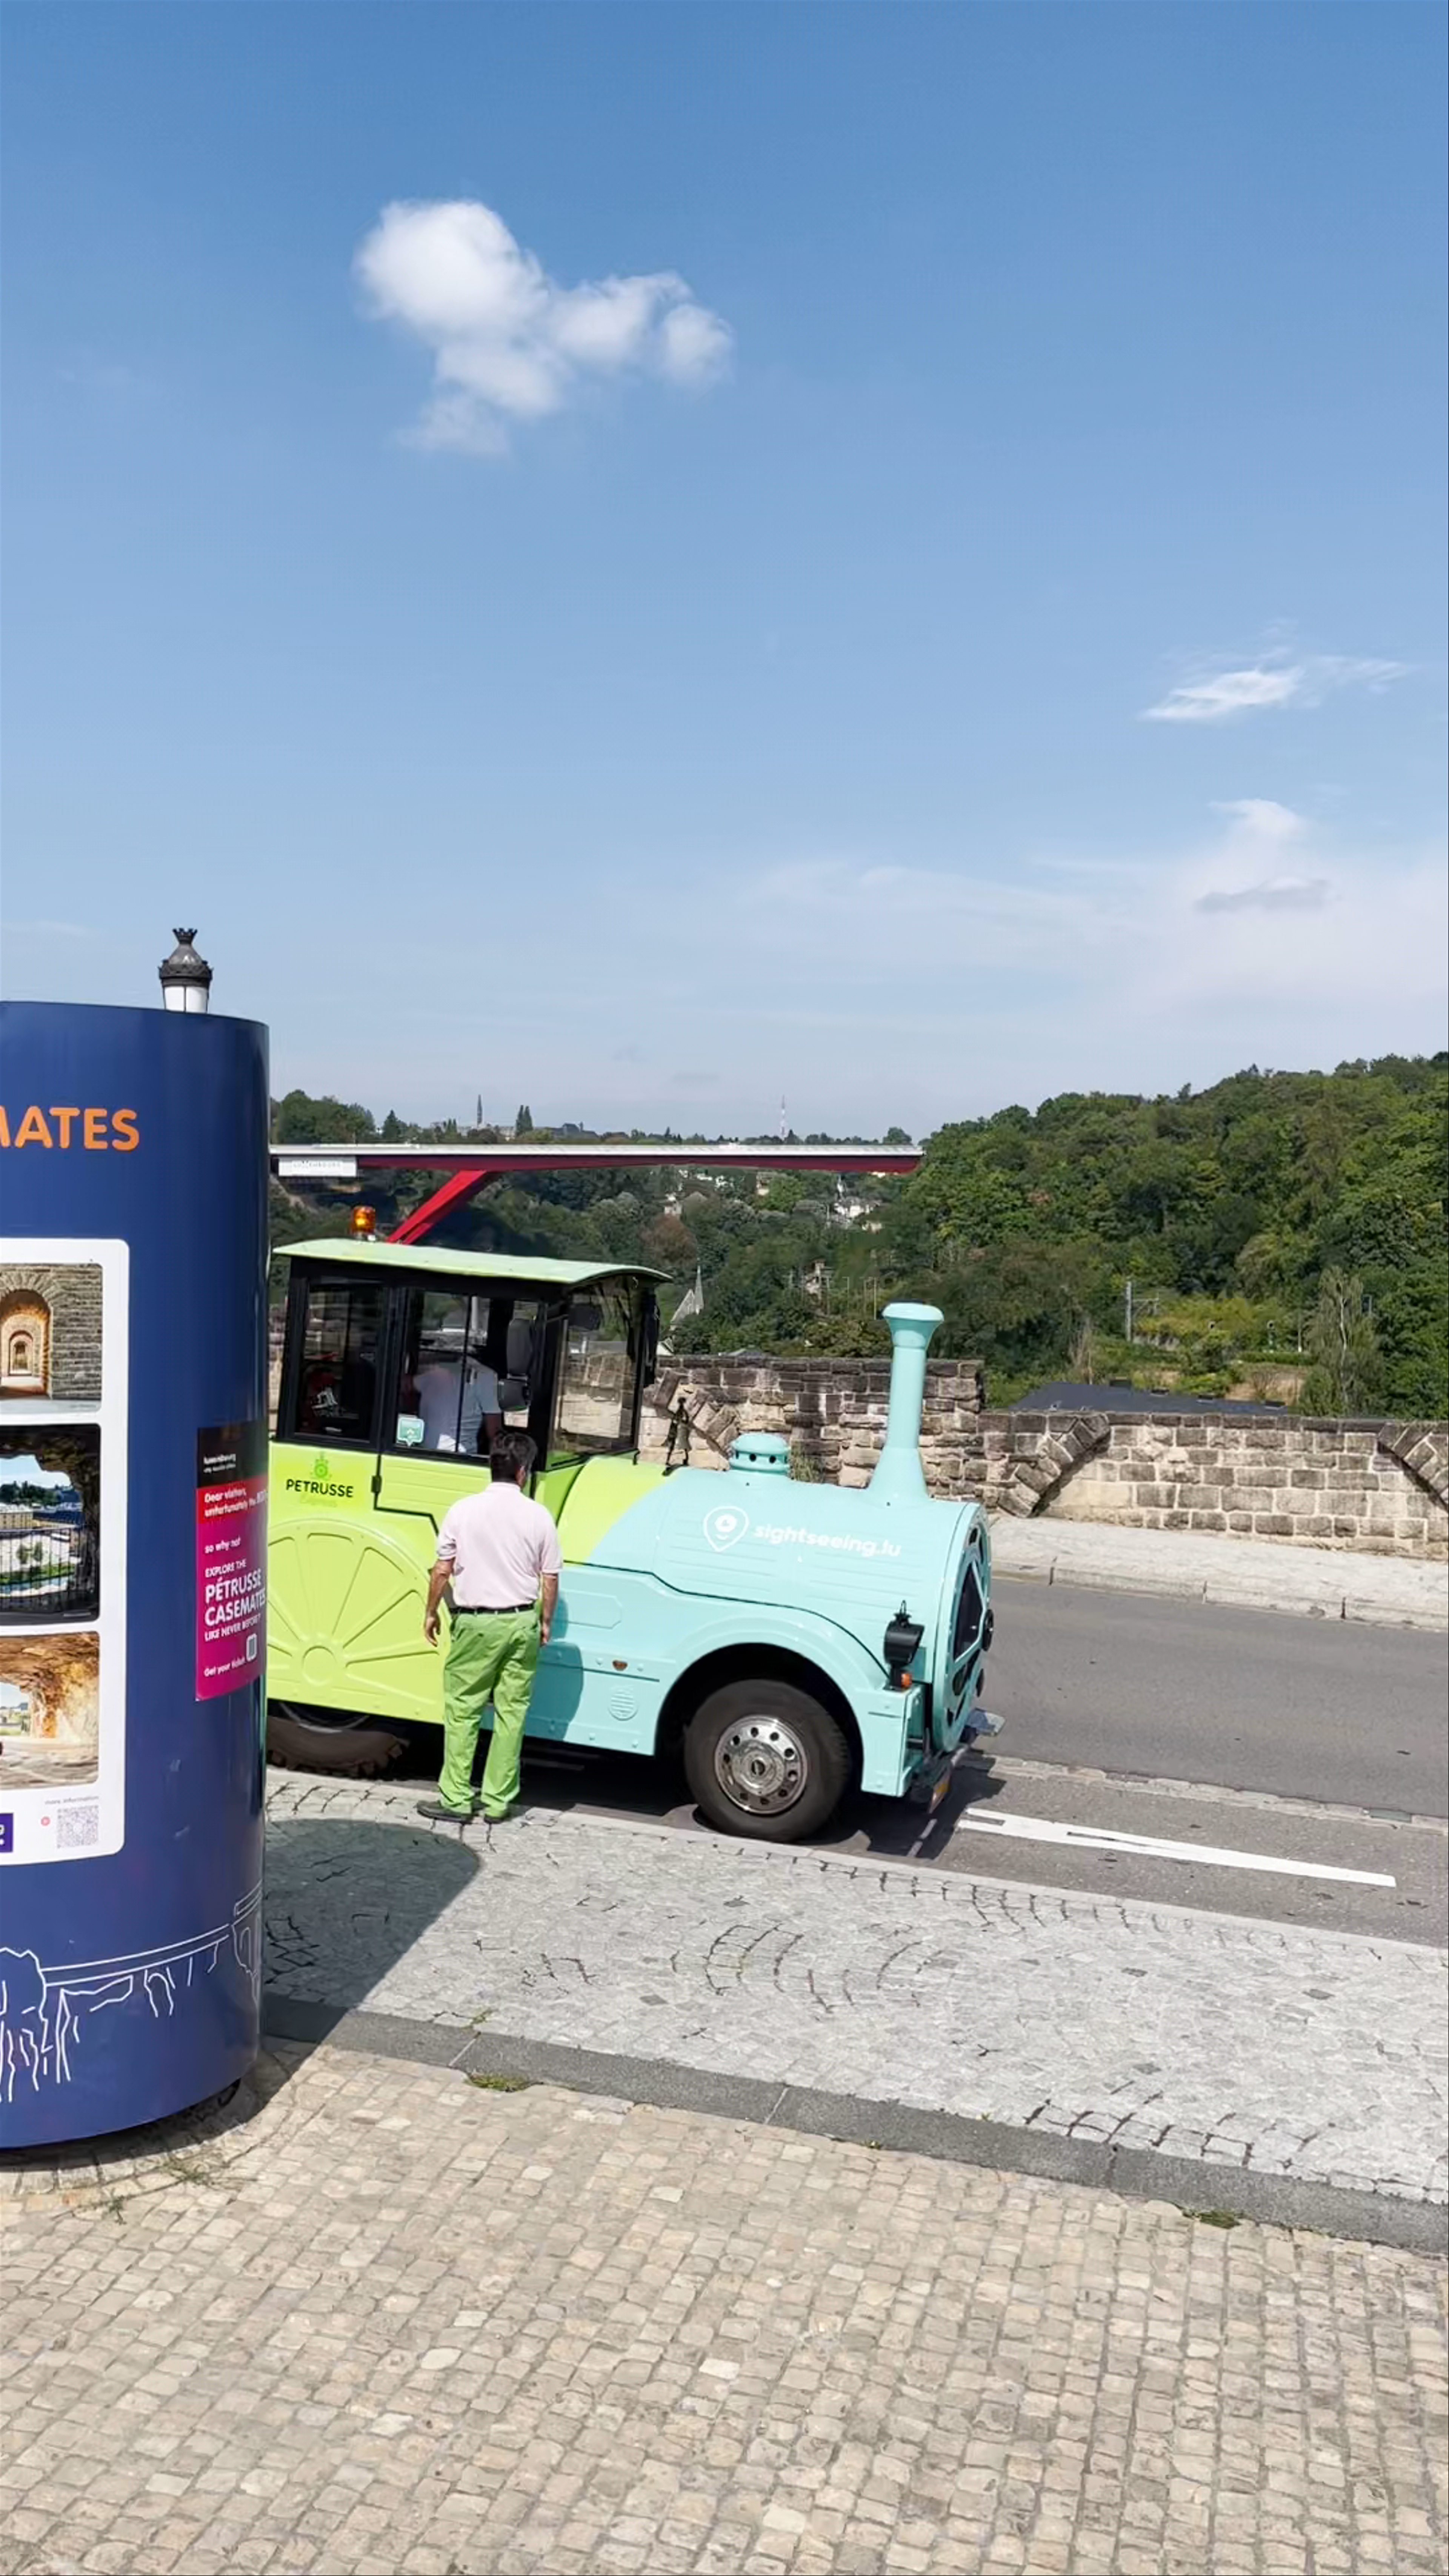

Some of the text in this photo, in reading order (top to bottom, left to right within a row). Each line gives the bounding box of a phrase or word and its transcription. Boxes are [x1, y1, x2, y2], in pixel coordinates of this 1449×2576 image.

[286, 1479, 354, 1498] PETRUSSE
[215, 1540, 230, 1551] why
[754, 1523, 901, 1557] sightseeing.lu
[205, 1558, 246, 1578] EXPLORE THE
[205, 1568, 262, 1603] PÉTRUSSE
[205, 1587, 266, 1626] CASEMATES
[204, 1628, 220, 1642] LIKE
[221, 1622, 241, 1636] NEVER
[204, 1667, 216, 1677] Get
[217, 1662, 231, 1675] your
